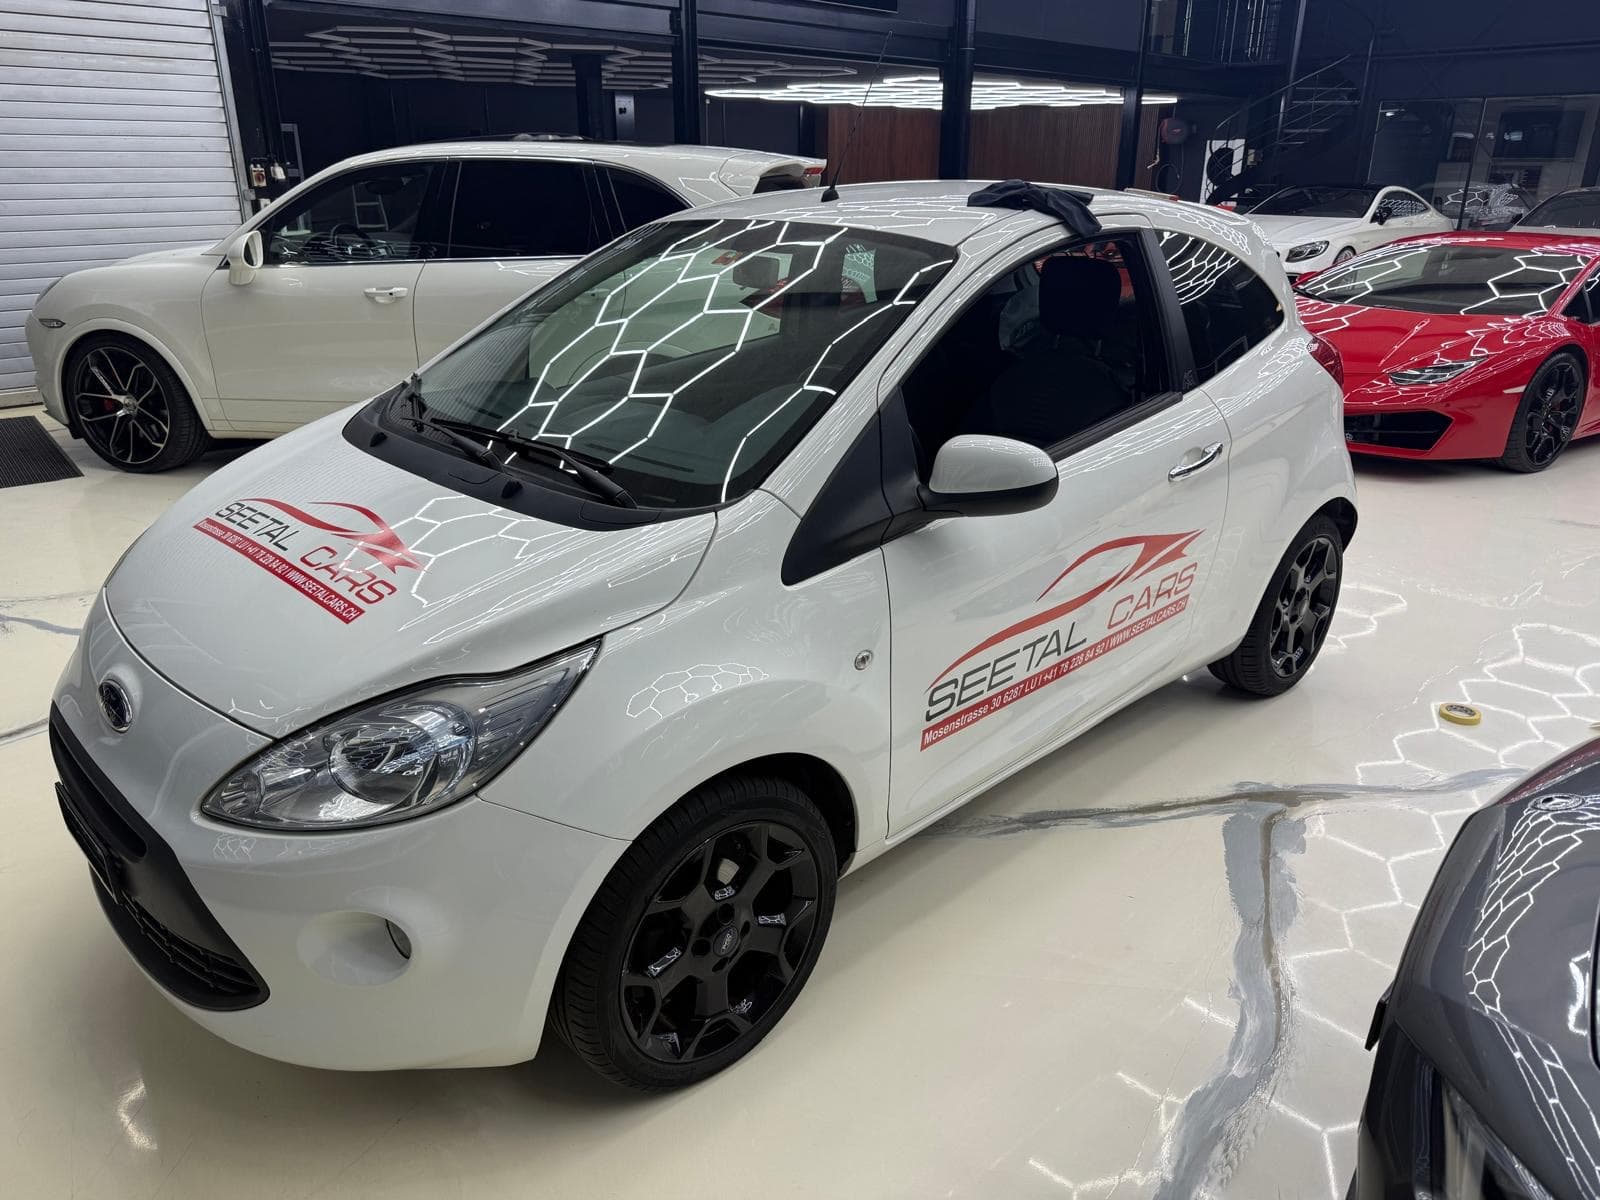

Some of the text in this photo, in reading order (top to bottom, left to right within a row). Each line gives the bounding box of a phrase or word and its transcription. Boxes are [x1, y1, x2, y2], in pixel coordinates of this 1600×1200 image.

[215, 502, 397, 604] SEETAL CARS
[285, 568, 360, 620] WWW.SEETALCARS.CH
[924, 703, 989, 746] Mosenstrasse
[990, 695, 1002, 711] 30
[1002, 684, 1024, 704] 6287
[1024, 677, 1038, 692] LU
[1042, 666, 1058, 684] +41
[1058, 660, 1070, 675] 78
[1108, 598, 1187, 648] WWW.SEETALCARS.CH
[925, 562, 1198, 722] SEETAL CARS
